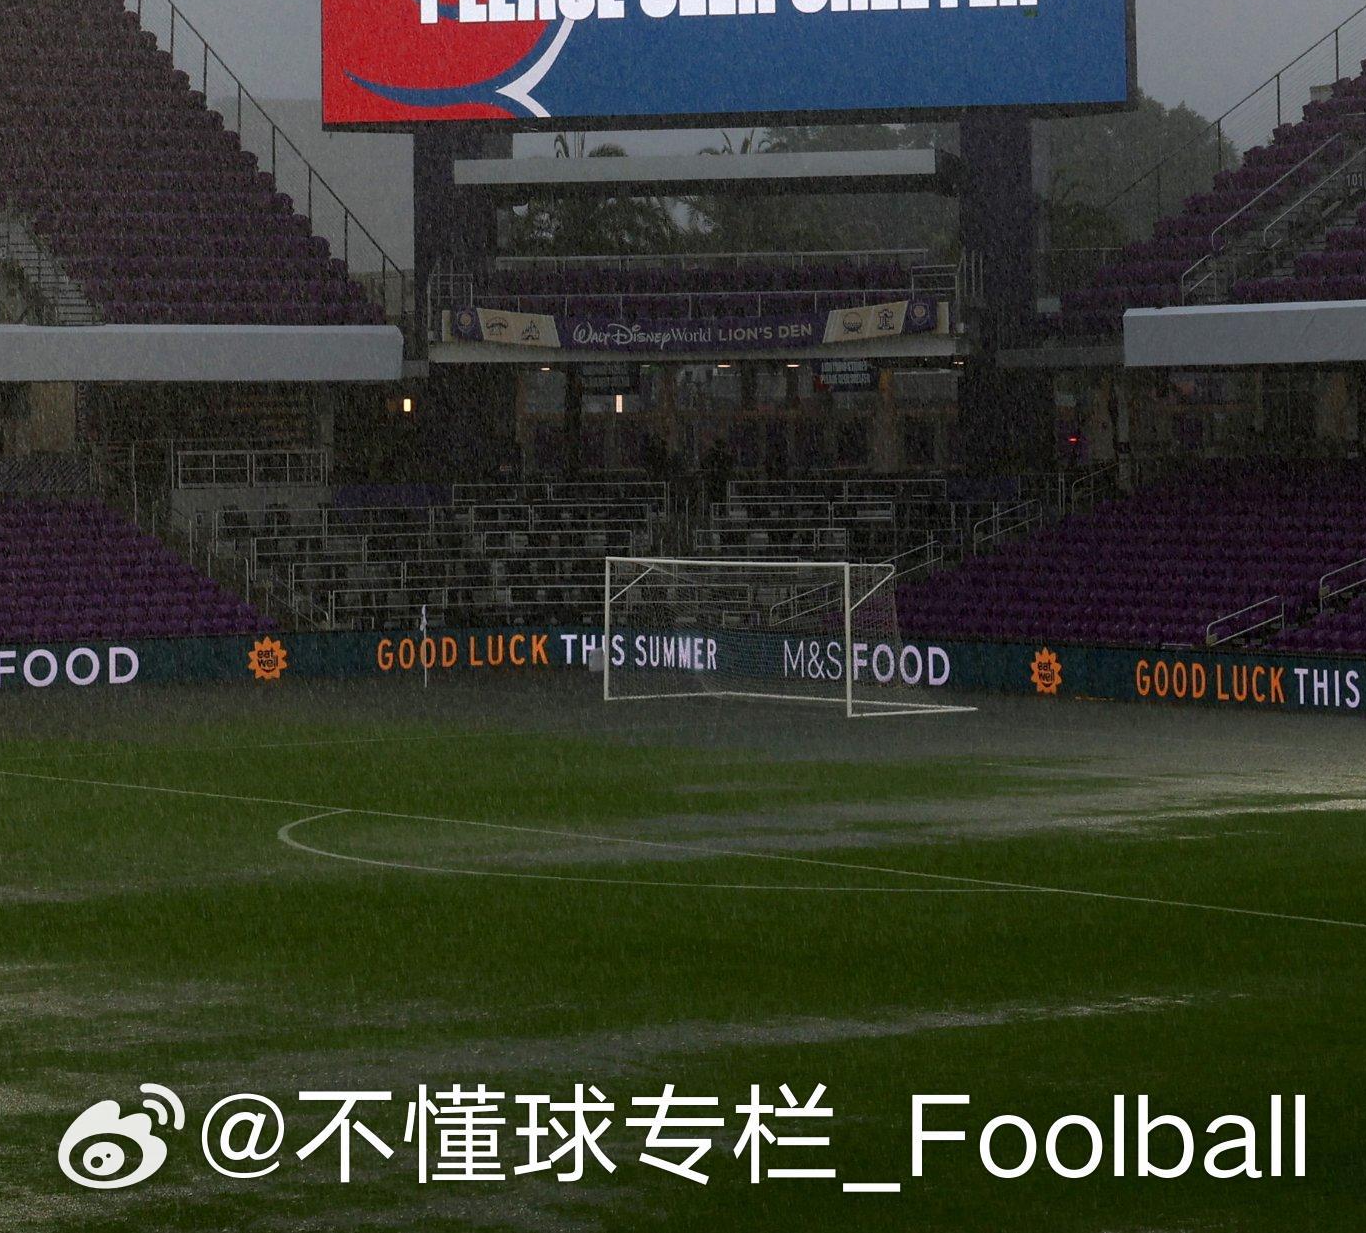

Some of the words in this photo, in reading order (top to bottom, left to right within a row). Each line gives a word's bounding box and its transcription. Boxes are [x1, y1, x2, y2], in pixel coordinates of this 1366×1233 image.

[1346, 173, 1363, 186] 101
[718, 326, 774, 343] LION'S
[779, 322, 813, 339] DEN
[257, 648, 275, 658] eat
[377, 635, 458, 670] GOOD
[469, 634, 549, 666] LUCK
[561, 634, 625, 666] THS
[635, 634, 718, 670] SUMMER
[783, 639, 843, 680] M&S
[852, 643, 951, 686] FOOD
[1136, 659, 1207, 698] GOOD
[1216, 665, 1285, 704] LUCK
[1294, 668, 1361, 709] THIS
